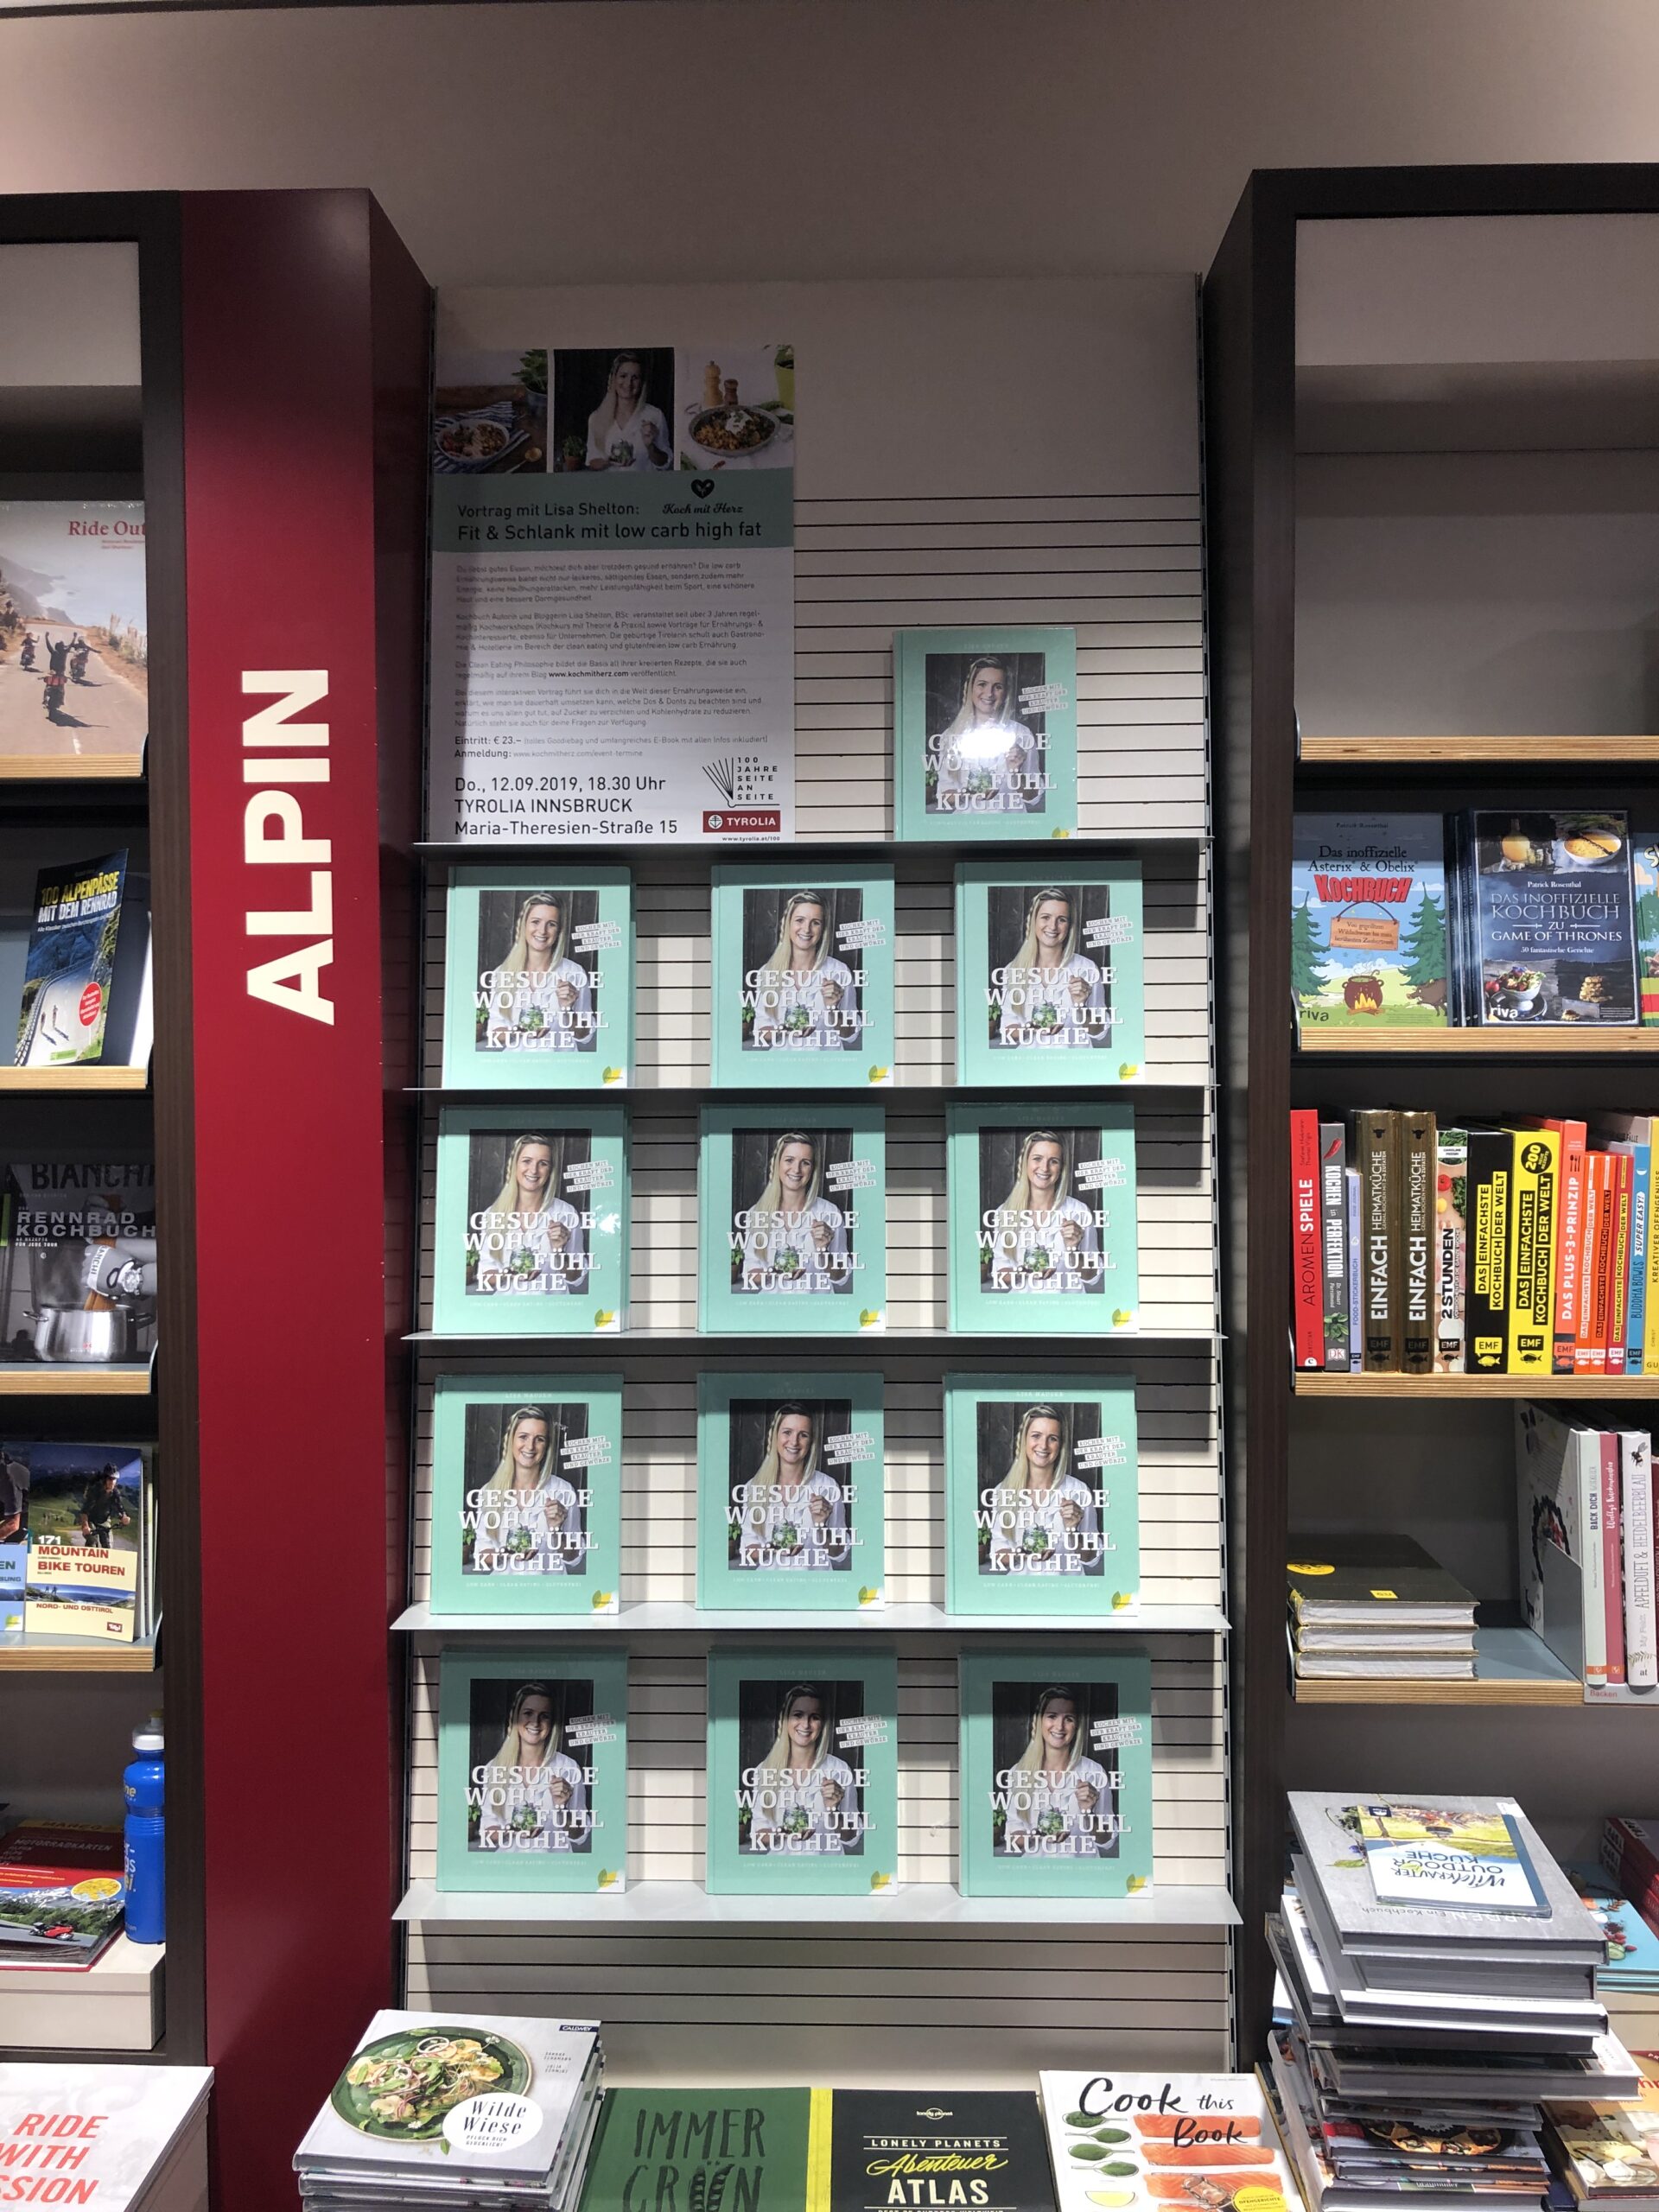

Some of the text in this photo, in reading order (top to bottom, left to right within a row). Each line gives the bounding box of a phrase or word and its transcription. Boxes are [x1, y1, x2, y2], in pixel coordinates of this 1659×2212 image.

[457, 501, 640, 519] Vortrag mit Lisa Shelton:
[662, 503, 743, 515] Koch mit Herz
[68, 518, 110, 537] Ride
[457, 521, 762, 541] Fit & Schlank mit low carb high fat
[548, 670, 629, 678] www.kochmitherz.com
[454, 736, 492, 746] Eintritt:
[493, 736, 500, 745] €
[454, 749, 512, 760] Anmeldung:
[454, 776, 666, 794] Do., 12.09.2019, 18.30 Uhr
[454, 798, 632, 814] TYROLIA INNSBRUCK
[454, 819, 677, 836] Maria-Theresien-Straße 15
[727, 816, 776, 827] TYROLIA
[242, 670, 334, 1026] ALPIN
[1318, 844, 1407, 859] Das inoffizielle
[1360, 861, 1371, 873] &
[41, 871, 119, 906] 100 ALPENPÄSSE
[1313, 874, 1413, 903] KOCHBUCH
[38, 891, 118, 923] MIT DEM RENNRAD
[1491, 893, 1620, 905] DAS INOFFIZIELLE
[1491, 905, 1619, 919] KOCHBUCH
[1548, 921, 1565, 931] ZU
[1491, 931, 1623, 942] GAME OF THRONES
[745, 969, 869, 988] GESUNDE
[807, 1006, 874, 1027] FÜHL
[1299, 1008, 1329, 1022] riva
[1490, 1006, 1518, 1020] riva
[753, 1025, 841, 1047] KÜCHE
[1526, 1144, 1541, 1171] 200
[1325, 1165, 1341, 1206] KOCHEN
[17, 1211, 135, 1224] RENNRAD
[16, 1225, 156, 1237] KOCHBUCH
[1371, 1150, 1389, 1320] EINFACH HEIMATKÜCHE
[1478, 1186, 1489, 1292] DAS EINFACHSTE
[1492, 1174, 1504, 1307] KOCHBUCH DER WELT
[1299, 1179, 1315, 1306] AROMENSPIELE
[1326, 1218, 1344, 1279] PERFEKTION
[1519, 1193, 1533, 1307] DAS EINFACHSTE
[1535, 1176, 1550, 1323] KOCHBUCH DER WELT
[1561, 1177, 1579, 1319] DAS PLUS-3-PRINZIP
[1630, 1195, 1645, 1319] BUDDHA BOWLS SUPER EASY!
[1650, 1233, 1659, 1284] KREATIVER
[1440, 1228, 1455, 1319] 2 STUNDEN
[1478, 1341, 1499, 1351] EMF
[1520, 1338, 1541, 1348] EMF
[1329, 1349, 1344, 1359] DK
[732, 1484, 858, 1503] GESUNDE
[1589, 1492, 1599, 1530] BACK DICH
[38, 1535, 61, 1545] 171
[795, 1522, 864, 1546] FÜHL
[38, 1546, 109, 1559] MOUNTAIN
[739, 1543, 830, 1567] KÜCHE
[38, 1561, 125, 1576] BIKE TOUREN
[1632, 1560, 1649, 1609] APFELDUFT
[1590, 1689, 1618, 1699] Backen
[472, 1765, 599, 1785] GESUNDE
[536, 1805, 604, 1828] FÜHL
[479, 1825, 569, 1849] KÜCHE
[1405, 1850, 1478, 1865] KÜCHE
[1078, 2077, 1236, 2117] Cook this
[472, 2100, 528, 2119] Wilde
[13, 2113, 109, 2139] RIDE
[463, 2116, 522, 2135] Wiese
[634, 2107, 766, 2158] IMMER
[1173, 2117, 1248, 2147] Book
[871, 2139, 1002, 2149] LONELY PLANETS
[0, 2145, 90, 2171] WITH
[867, 2152, 1008, 2178] Abenteuer
[888, 2178, 988, 2205] ATLAS
